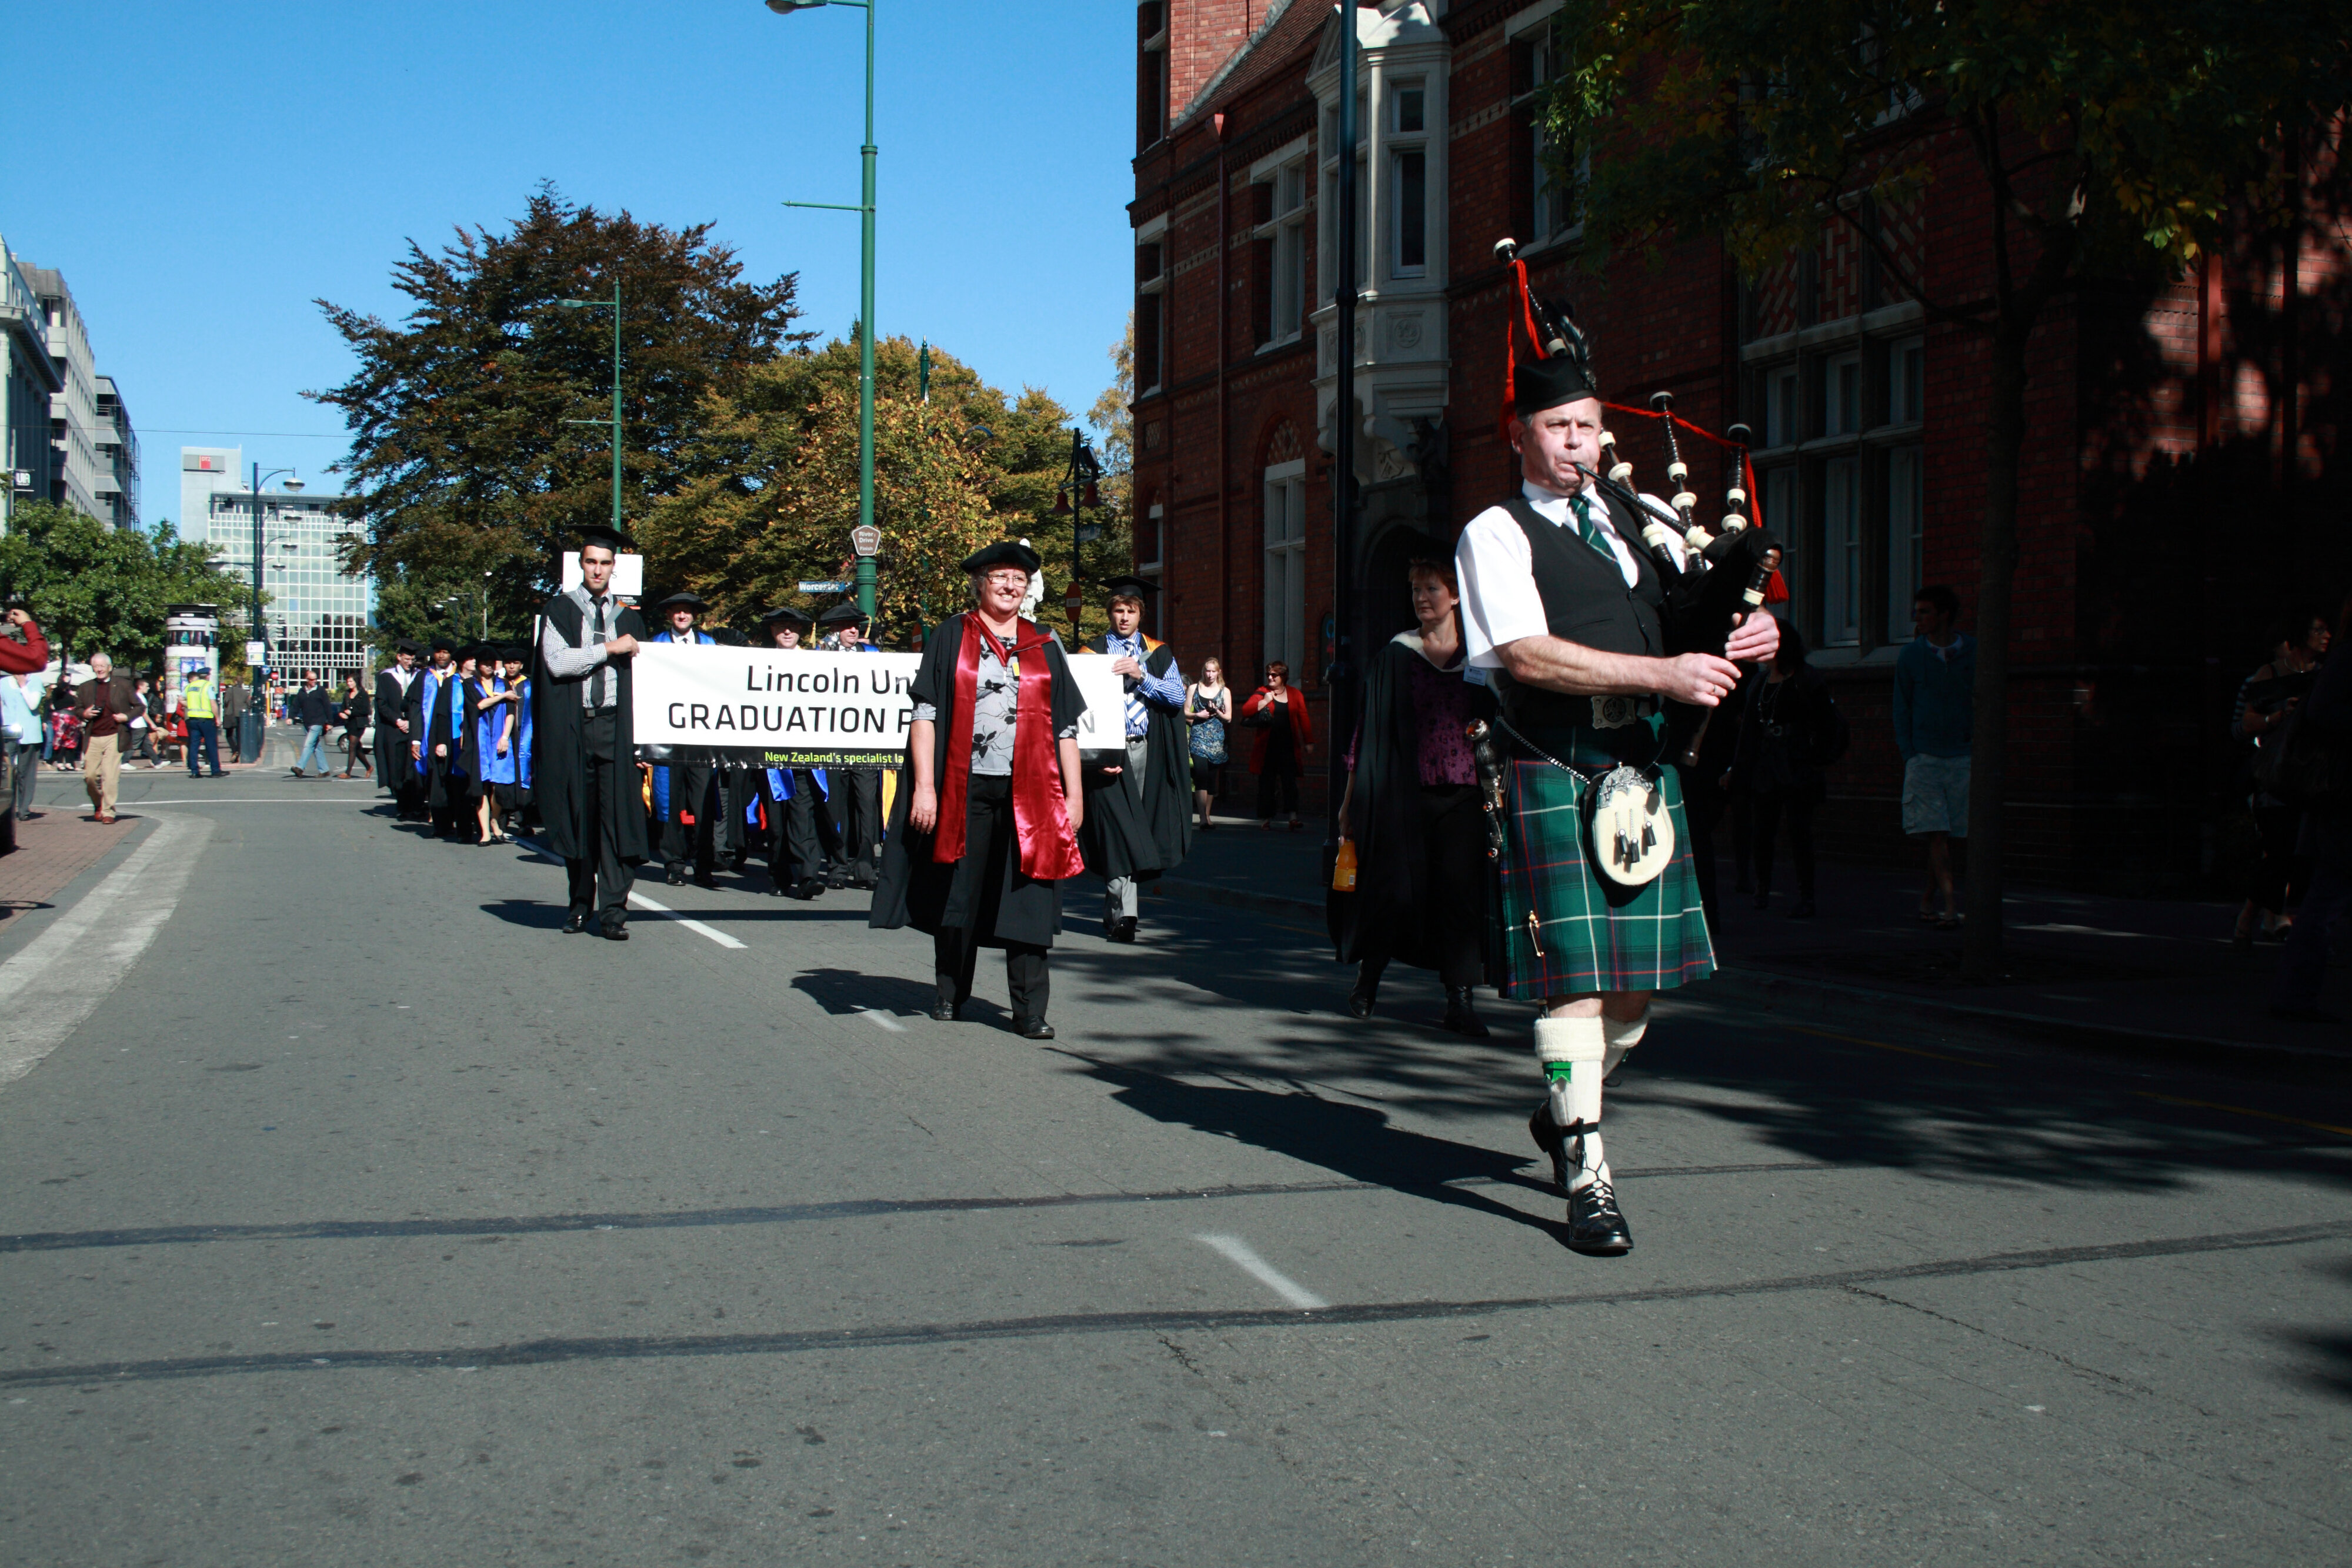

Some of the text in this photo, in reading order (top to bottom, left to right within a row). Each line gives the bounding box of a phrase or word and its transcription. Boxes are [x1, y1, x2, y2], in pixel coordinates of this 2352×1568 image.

[748, 665, 919, 694] Lincoln Un
[669, 703, 885, 733] GRADUATION
[765, 752, 788, 762] New
[791, 752, 841, 763] Zealand's
[844, 753, 892, 765] specialist
